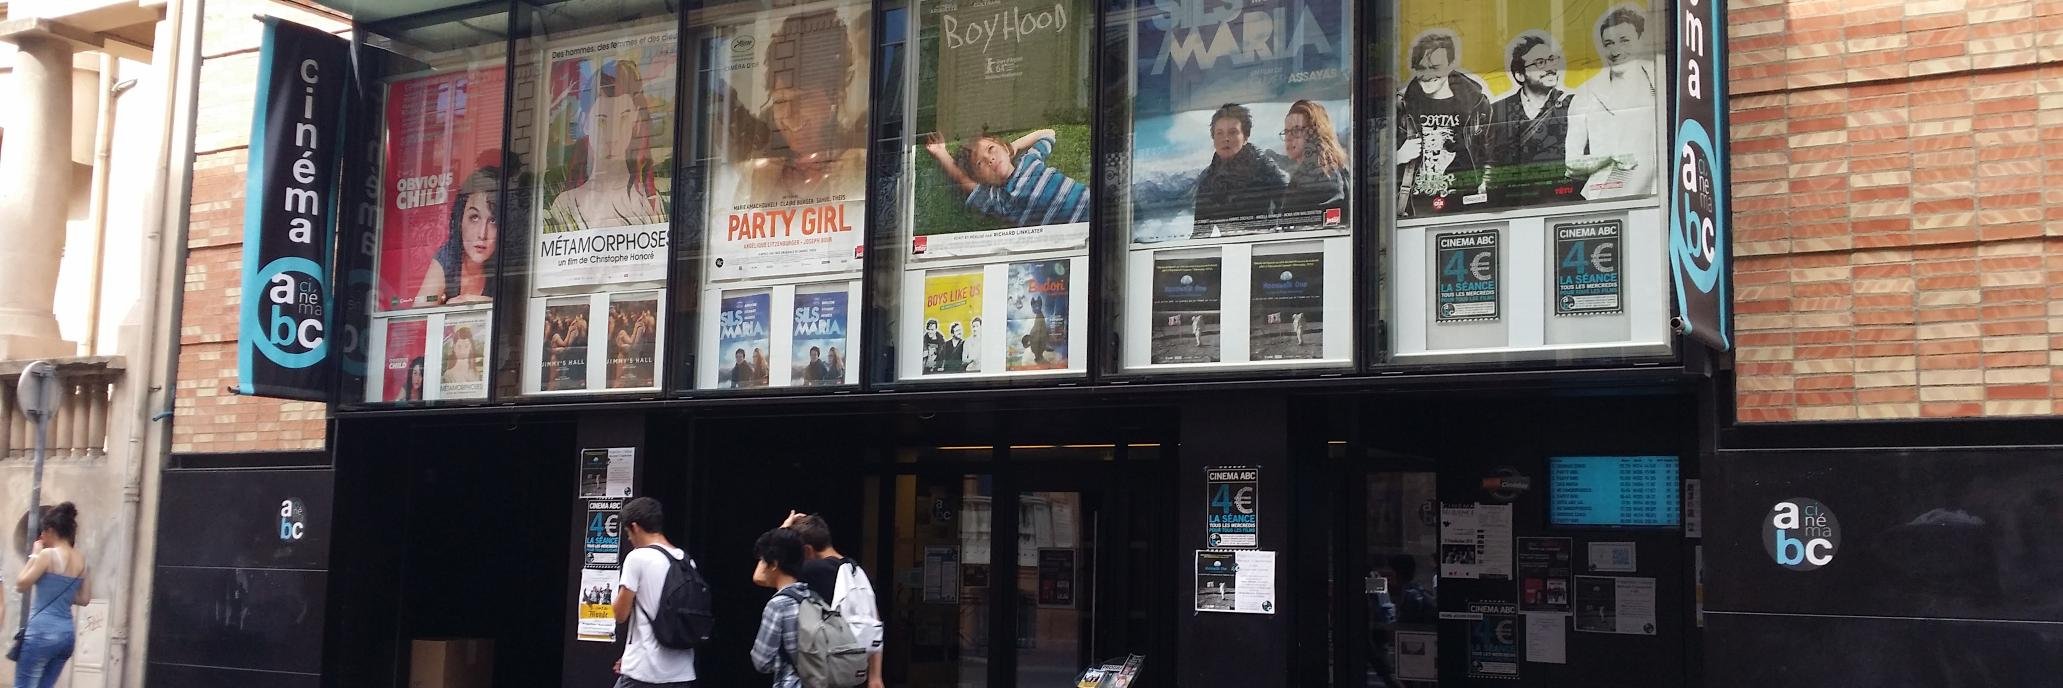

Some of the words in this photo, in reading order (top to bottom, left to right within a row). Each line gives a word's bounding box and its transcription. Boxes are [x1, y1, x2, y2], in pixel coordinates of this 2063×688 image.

[1150, 5, 1332, 75] MARIA
[1288, 68, 1337, 83] ASSAYAS
[284, 58, 319, 244] cinéma
[397, 172, 453, 192] OBVIOUS
[396, 187, 448, 210] CHILD
[727, 208, 797, 241] PARTY
[801, 204, 852, 236] GIRL
[1016, 228, 1044, 236] LINKLATER
[1560, 228, 1596, 238] CINEMA
[1597, 226, 1617, 236] ABC
[1441, 238, 1475, 248] CINEMA
[1476, 236, 1495, 245] ABC
[567, 257, 578, 266] film
[579, 256, 588, 264] de
[590, 251, 629, 264] Christophe
[629, 250, 655, 261] Honoré
[1441, 284, 1453, 292] LA
[1455, 280, 1495, 291] SÉANCE
[1560, 276, 1573, 285] LA
[1576, 273, 1617, 284] SÉANCE
[928, 291, 947, 307] BOYS
[950, 287, 968, 304] LIKE
[969, 282, 981, 298] US
[720, 309, 743, 326] SILS
[795, 306, 820, 323] SILS
[720, 320, 763, 340] MARIA
[795, 318, 841, 336] MARIA
[1209, 472, 1239, 480] CINEMA
[1240, 472, 1256, 480] ABC
[590, 502, 608, 510] CINEMA
[609, 501, 621, 509] ABC
[1209, 515, 1220, 523] LA
[1222, 513, 1256, 523] SÉANCE
[586, 537, 595, 545] LA
[1470, 605, 1499, 613] CINEMA
[1500, 606, 1516, 614] ABC
